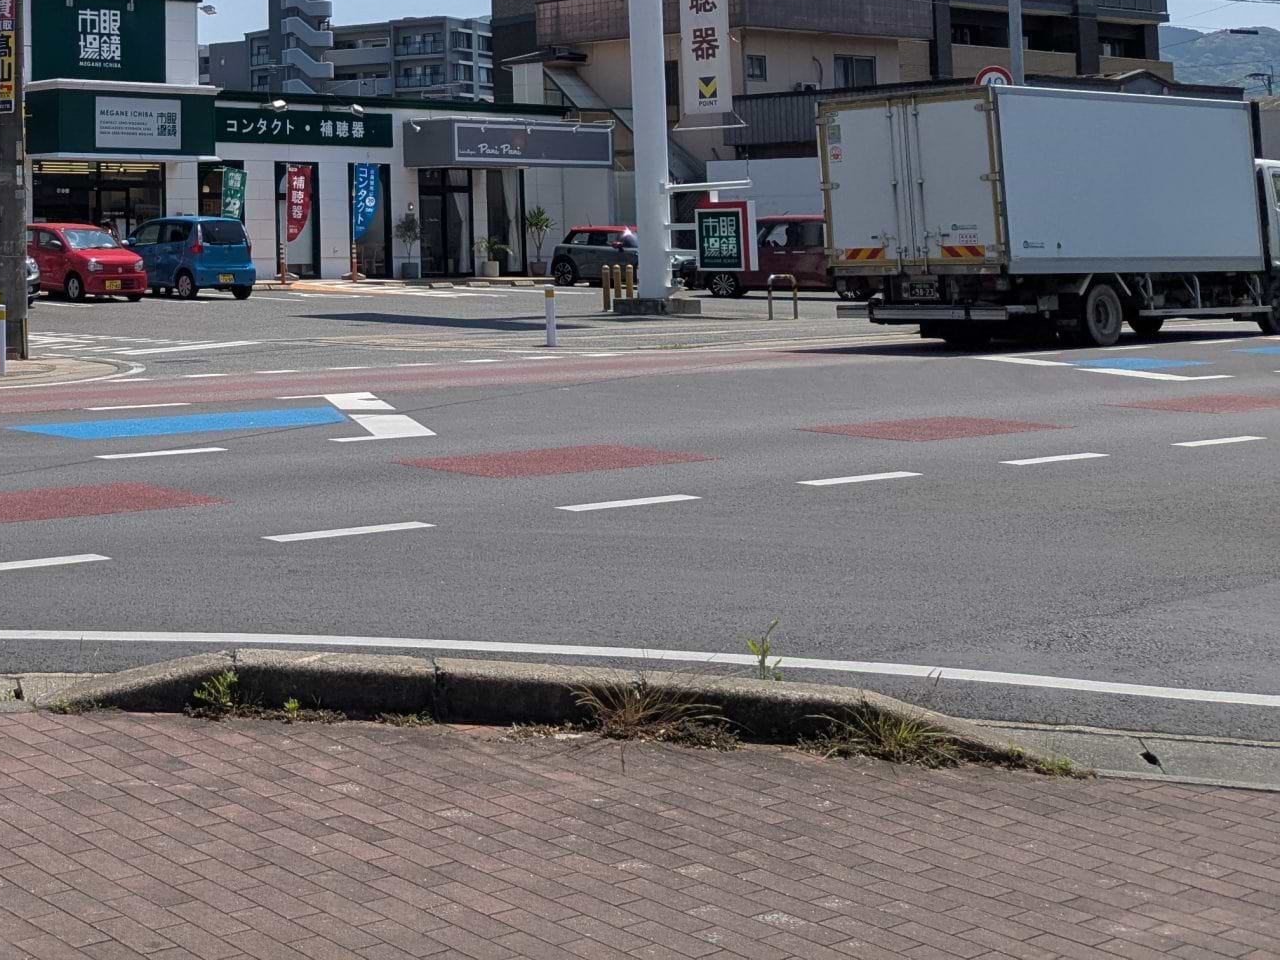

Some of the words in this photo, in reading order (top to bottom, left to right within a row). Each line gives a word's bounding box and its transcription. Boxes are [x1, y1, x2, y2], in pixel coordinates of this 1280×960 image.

[291, 176, 305, 218] 補聴器
[357, 167, 368, 225] コンタクト
